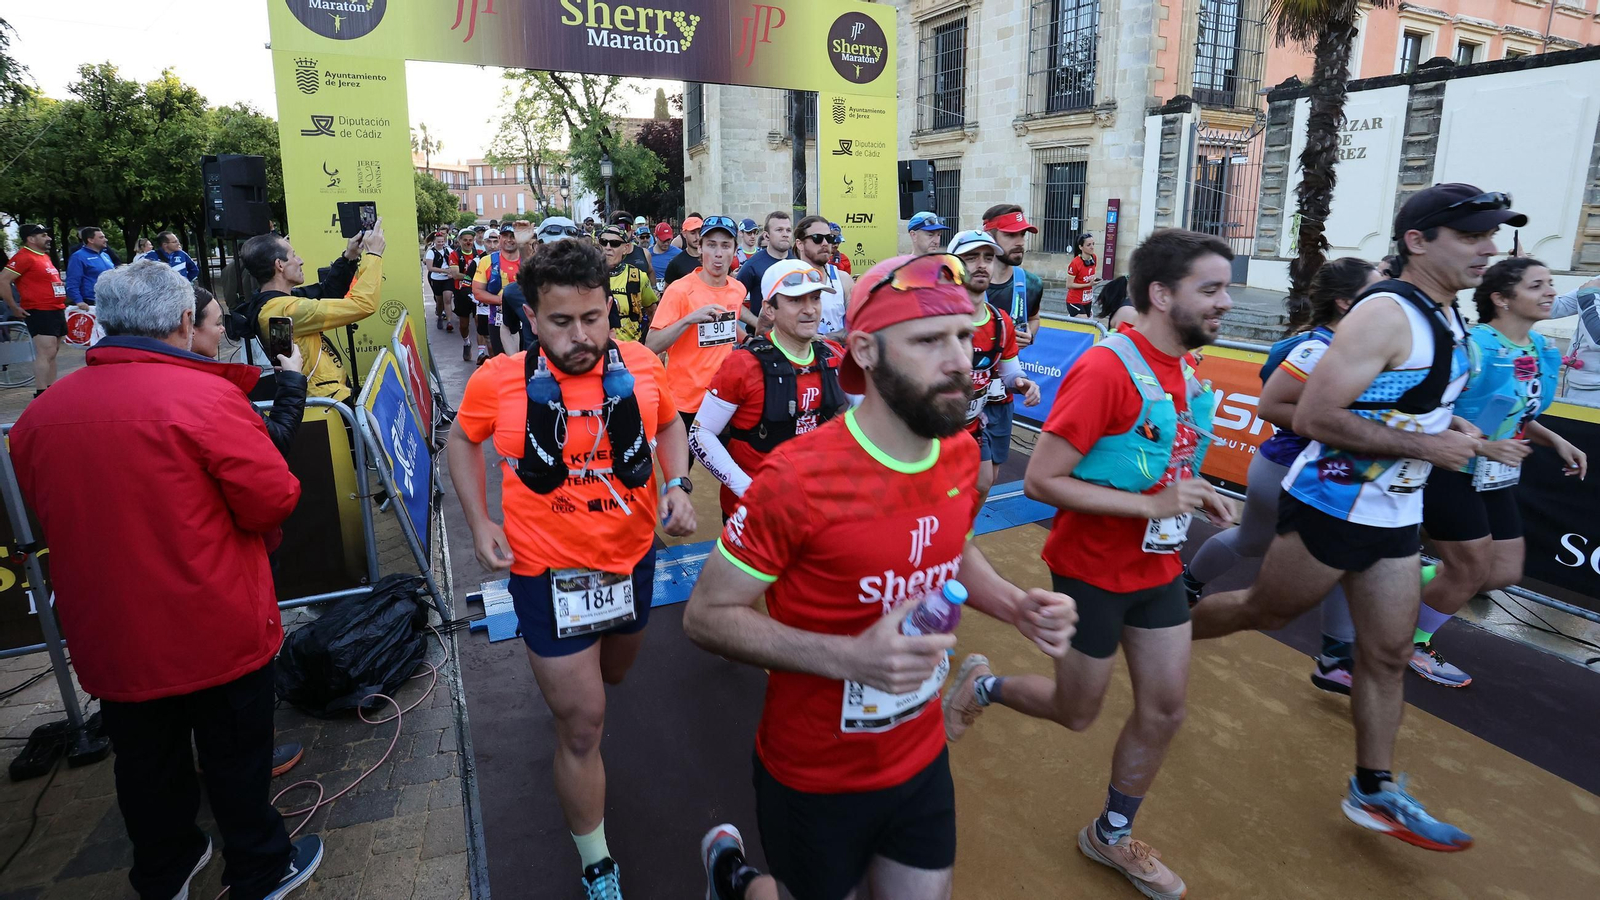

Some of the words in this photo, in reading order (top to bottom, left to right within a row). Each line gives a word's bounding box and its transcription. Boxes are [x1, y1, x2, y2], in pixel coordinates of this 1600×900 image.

[560, 0, 700, 51] Sherry
[586, 28, 680, 54] Maratón
[832, 38, 883, 63] Sherry
[841, 53, 876, 64] Maratón
[324, 70, 387, 82] Ayuntamiento
[325, 78, 336, 87] de
[338, 79, 361, 88] Jerez
[849, 106, 886, 115] Ayuntamiento
[338, 115, 390, 128] Diputación
[1338, 117, 1383, 132] AZAR
[340, 129, 352, 139] de
[355, 128, 382, 139] Cádiz
[855, 140, 886, 149] Diputación
[864, 150, 881, 158] Cádiz
[1338, 147, 1367, 161] REZ
[845, 213, 873, 224] HSN
[713, 321, 725, 334] 90
[1019, 360, 1062, 378] amiento
[581, 586, 615, 611] 184
